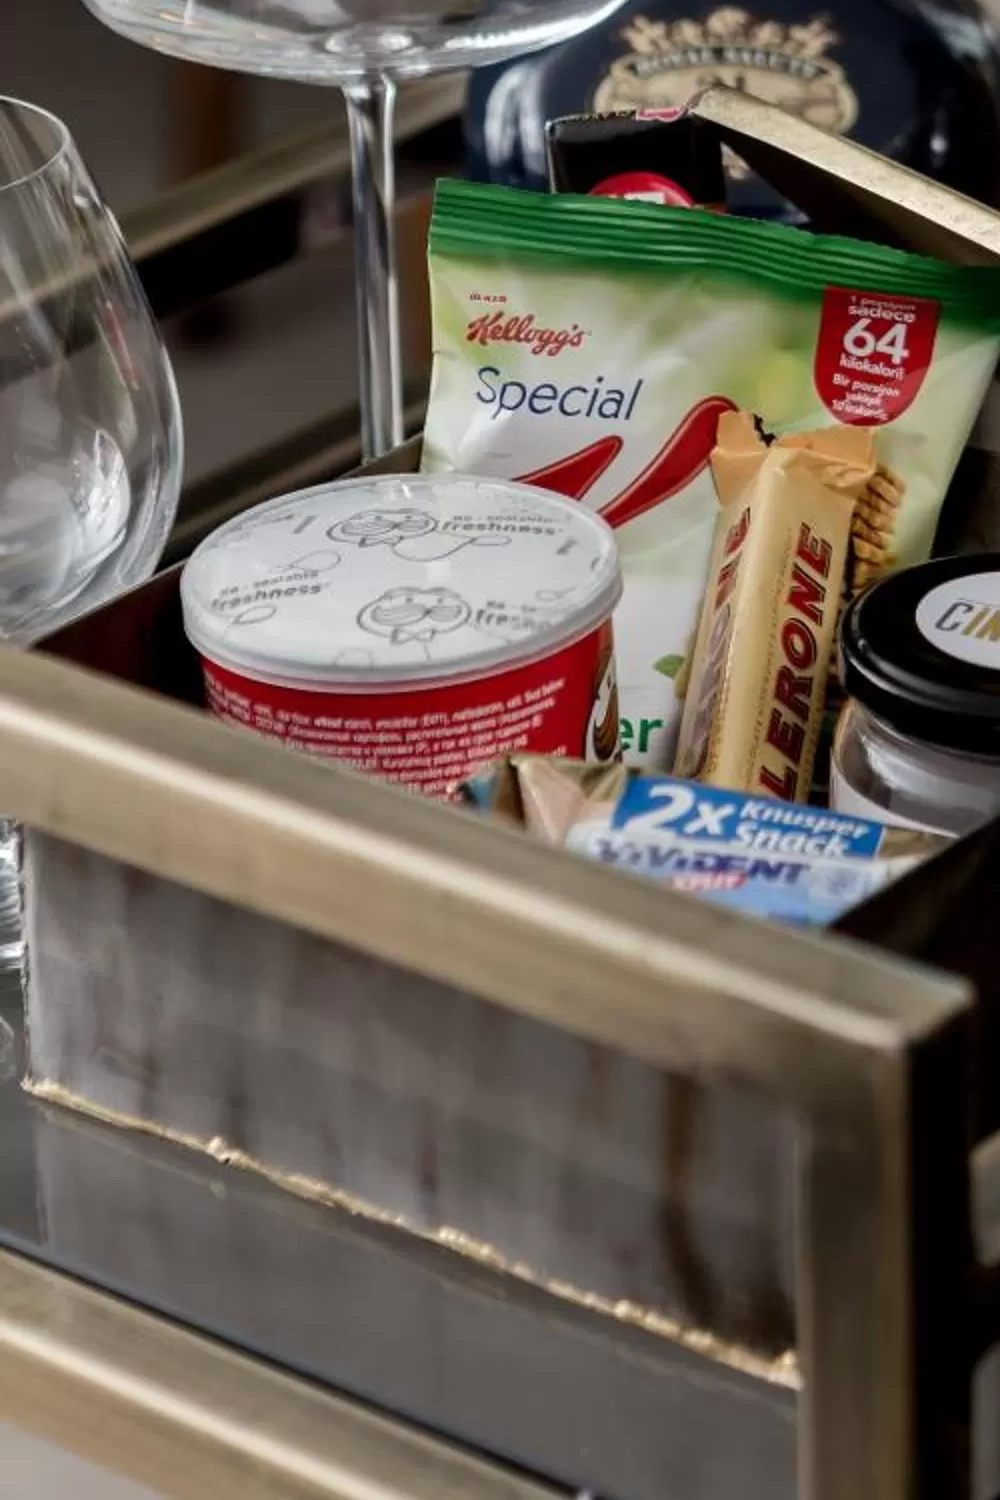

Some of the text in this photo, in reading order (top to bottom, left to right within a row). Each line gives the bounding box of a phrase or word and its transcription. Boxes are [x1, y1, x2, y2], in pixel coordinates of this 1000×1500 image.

[467, 310, 586, 357] Kellogg's
[848, 304, 917, 324] sadece
[843, 318, 909, 365] 64
[476, 366, 644, 421] Special
[624, 783, 736, 839] 2x
[740, 799, 871, 840] Knusper
[734, 820, 851, 858] Snack
